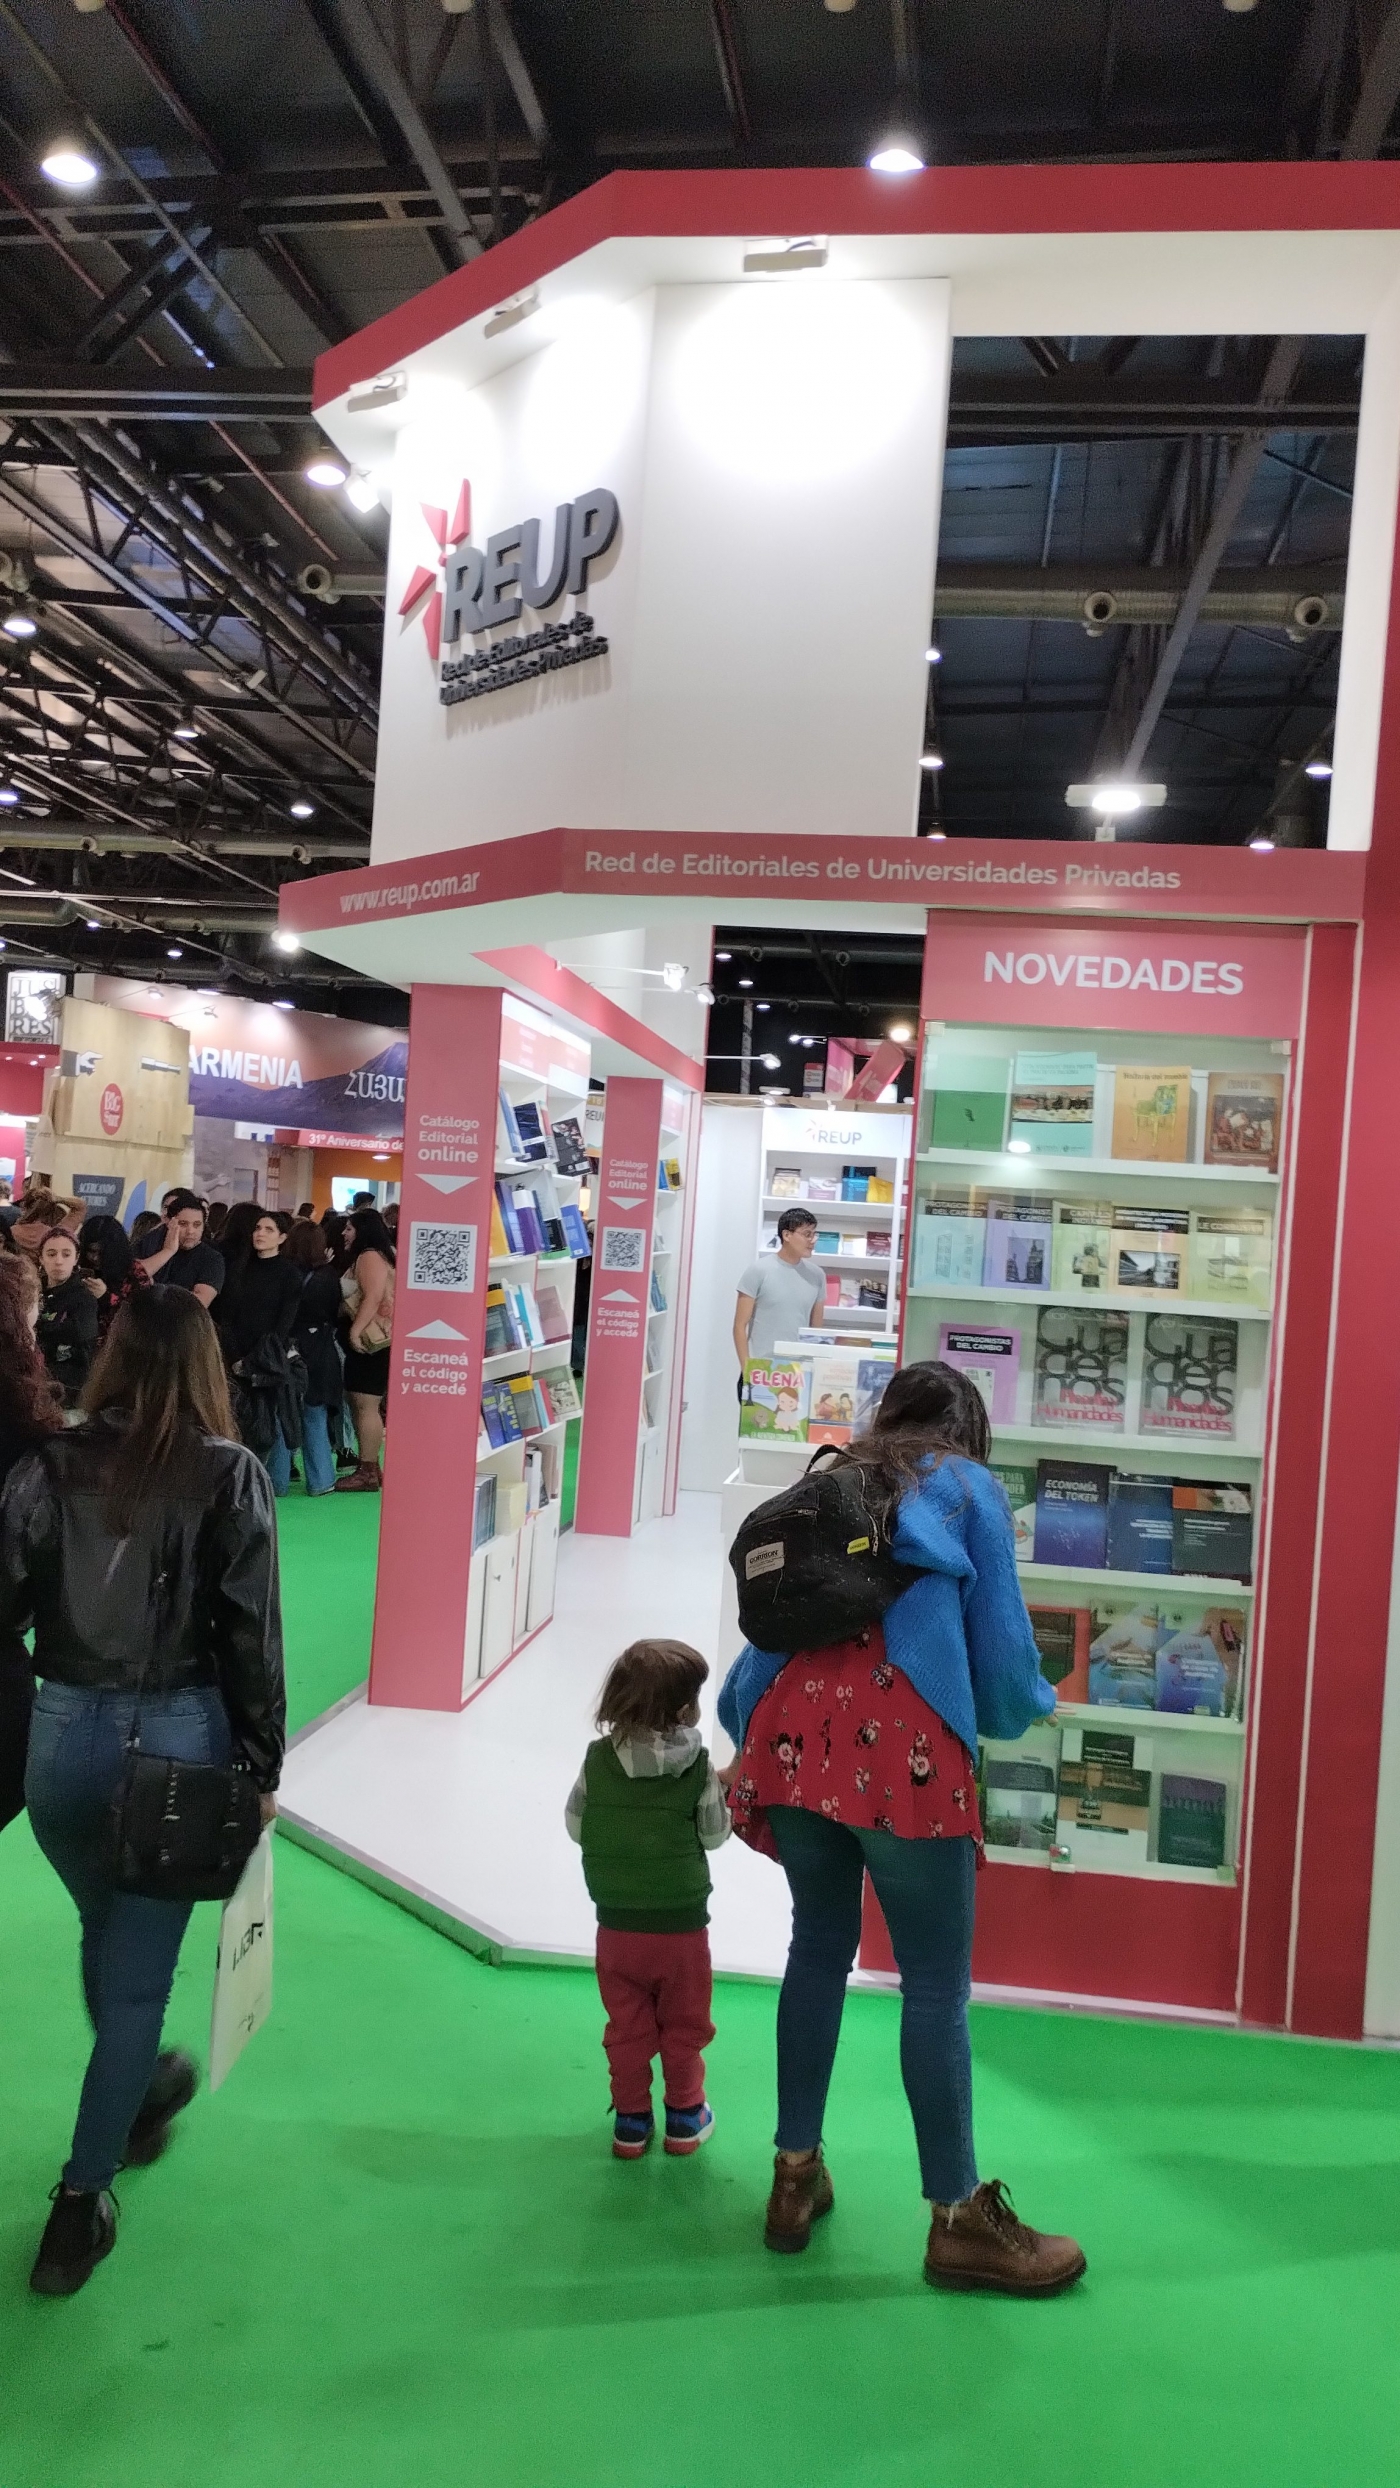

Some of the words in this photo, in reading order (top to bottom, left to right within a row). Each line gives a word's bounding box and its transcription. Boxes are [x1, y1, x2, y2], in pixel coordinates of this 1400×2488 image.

[443, 488, 618, 643] REUP
[584, 851, 635, 873] Red
[642, 853, 676, 874] de
[683, 853, 819, 879] Editoriales
[826, 856, 861, 880] de
[868, 857, 1057, 886] Universidades
[1064, 863, 1181, 889] Privadas
[340, 871, 480, 913] www.reup.com.ar
[983, 950, 1245, 996] NOVEDADES
[188, 1044, 304, 1089] ARMENIA
[419, 1114, 479, 1130] Catálogo
[327, 1134, 390, 1150] Aniversario
[418, 1131, 478, 1145] Editorial
[817, 1130, 862, 1145] REUP
[418, 1145, 479, 1163] online
[609, 1159, 648, 1170] Catálogo
[609, 1169, 648, 1180] Editorial
[608, 1178, 648, 1191] online
[597, 1307, 640, 1319] Escaneá
[597, 1317, 608, 1327] el
[609, 1318, 639, 1330] código
[596, 1328, 603, 1337] y
[604, 1326, 639, 1338] accedé
[949, 1335, 1012, 1345] PROTAGONISTAS
[972, 1343, 1004, 1351] CAMBIO
[403, 1349, 469, 1366] Escaneá
[402, 1366, 418, 1378] el
[420, 1367, 468, 1382] código
[751, 1370, 805, 1388] ELENA
[401, 1383, 411, 1394] y
[413, 1382, 467, 1396] accedé
[1045, 1479, 1098, 1492] ECONOMÍA
[1045, 1490, 1063, 1499] DEL
[1066, 1491, 1099, 1502] TOKEN
